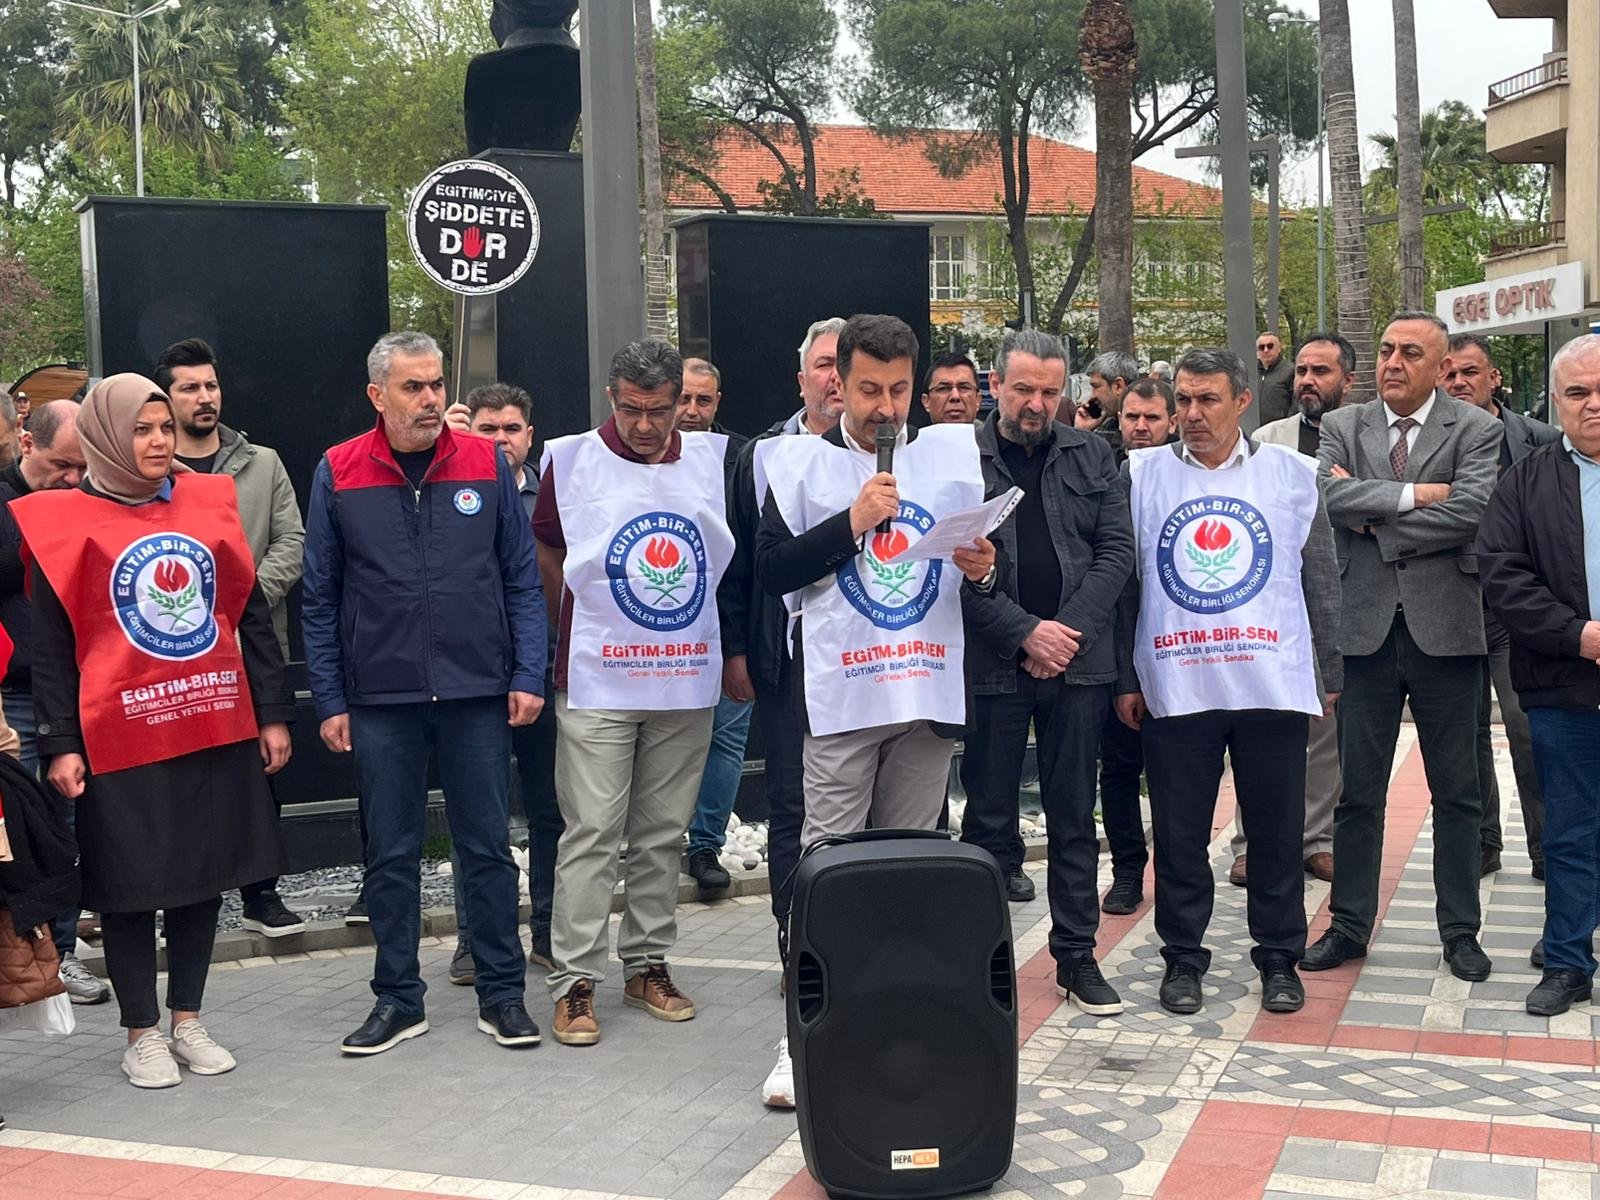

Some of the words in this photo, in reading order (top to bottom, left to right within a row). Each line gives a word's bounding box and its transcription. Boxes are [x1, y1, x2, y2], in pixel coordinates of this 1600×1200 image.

[450, 258, 489, 283] DE
[1452, 291, 1490, 323] EGE
[147, 712, 180, 725] GENEL
[893, 1154, 912, 1164] HEPA
